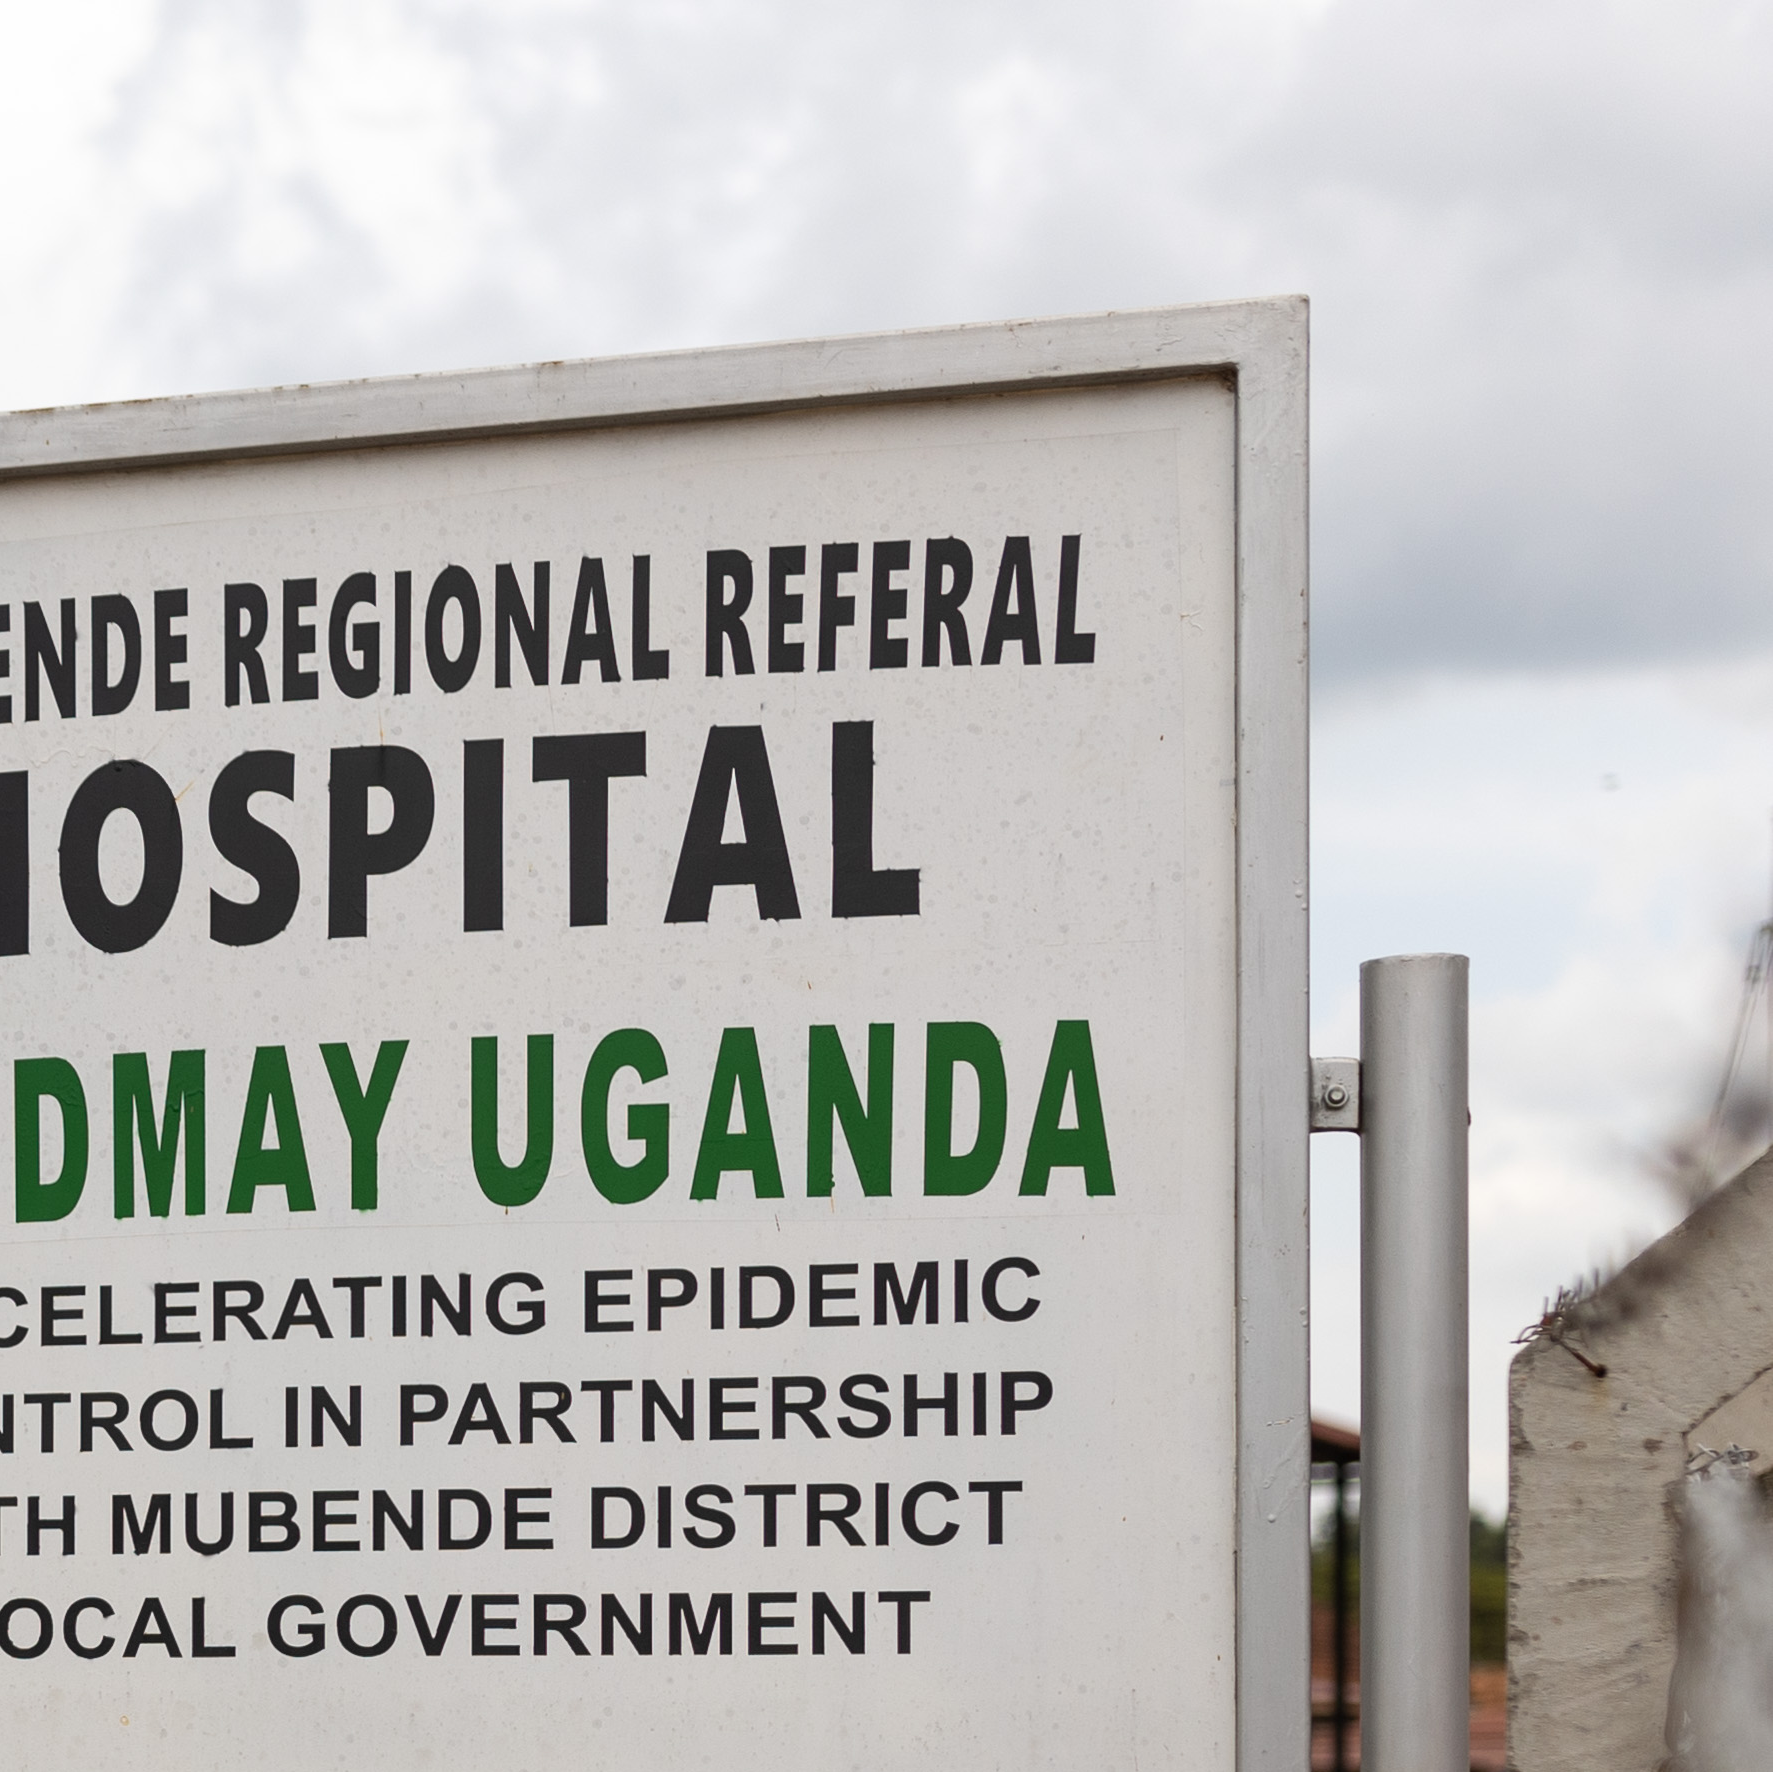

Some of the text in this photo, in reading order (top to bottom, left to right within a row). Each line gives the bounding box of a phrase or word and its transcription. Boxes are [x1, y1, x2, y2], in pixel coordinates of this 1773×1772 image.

[224, 555, 669, 708] REGIONAL
[705, 534, 1096, 678] REFERAL
[471, 1020, 1116, 1207] UGANDA
[585, 1257, 1040, 1332] EPIDEMIC
[286, 1386, 361, 1447] IN
[400, 1371, 1053, 1446] PARTNERSHIP
[112, 1488, 553, 1556] MUBENDE
[591, 1481, 1022, 1549] DISTRICT
[267, 1591, 930, 1657] GOVERNMENT
